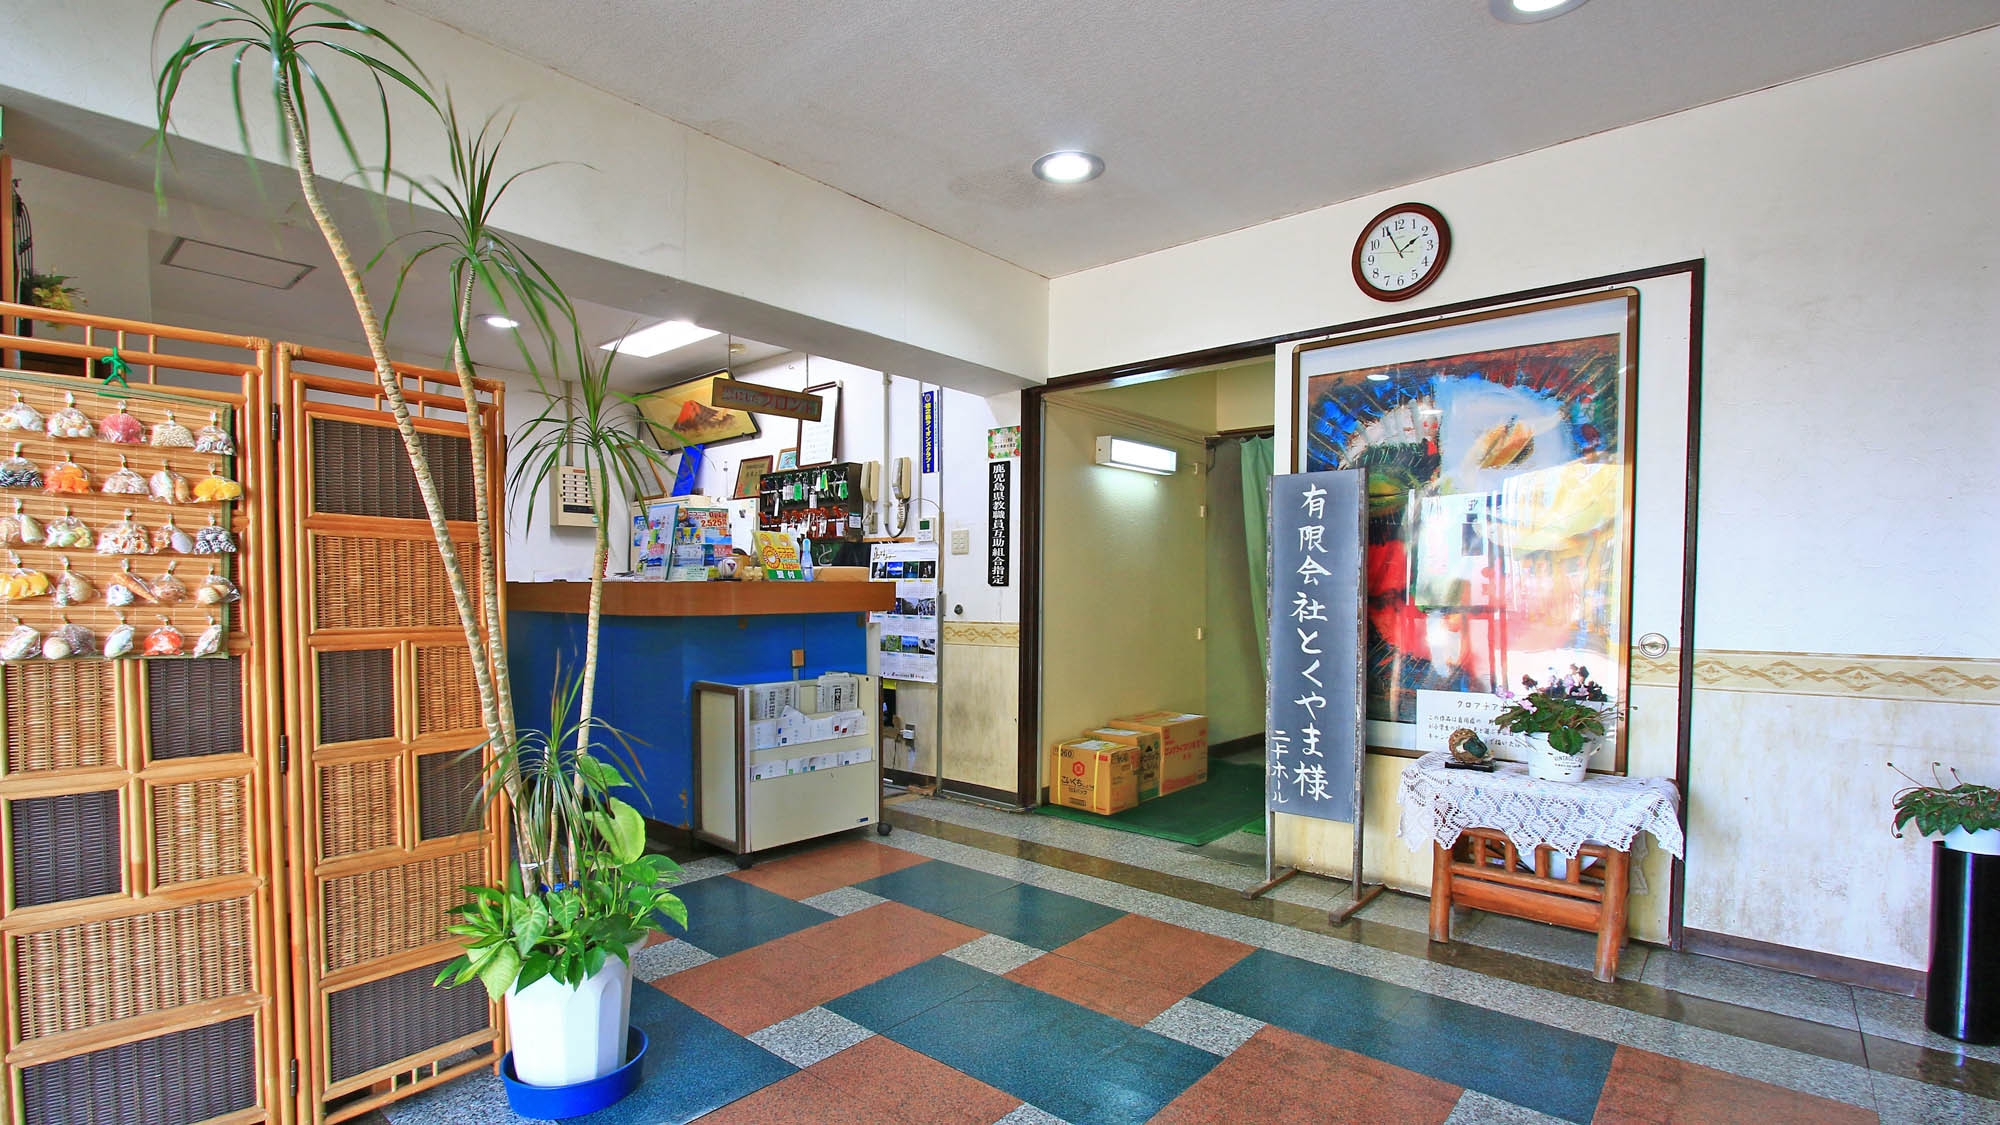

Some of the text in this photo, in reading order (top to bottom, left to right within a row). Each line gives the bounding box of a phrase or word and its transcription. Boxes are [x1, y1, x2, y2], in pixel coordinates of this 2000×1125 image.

[1394, 219, 1405, 231] 12
[1412, 219, 1416, 229] 1
[1421, 225, 1429, 236] 2
[1370, 239, 1380, 251] 10
[1426, 239, 1434, 251] 3
[1367, 255, 1375, 266] 9
[1421, 255, 1429, 267] 4
[1372, 268, 1379, 279] 8
[1411, 269, 1418, 280] 5
[1384, 275, 1391, 287] 7
[1397, 275, 1404, 286] 6
[991, 464, 1006, 585] 鹿児島県教職員互助組合指定
[1289, 483, 1333, 801] 有限会社とくやま様
